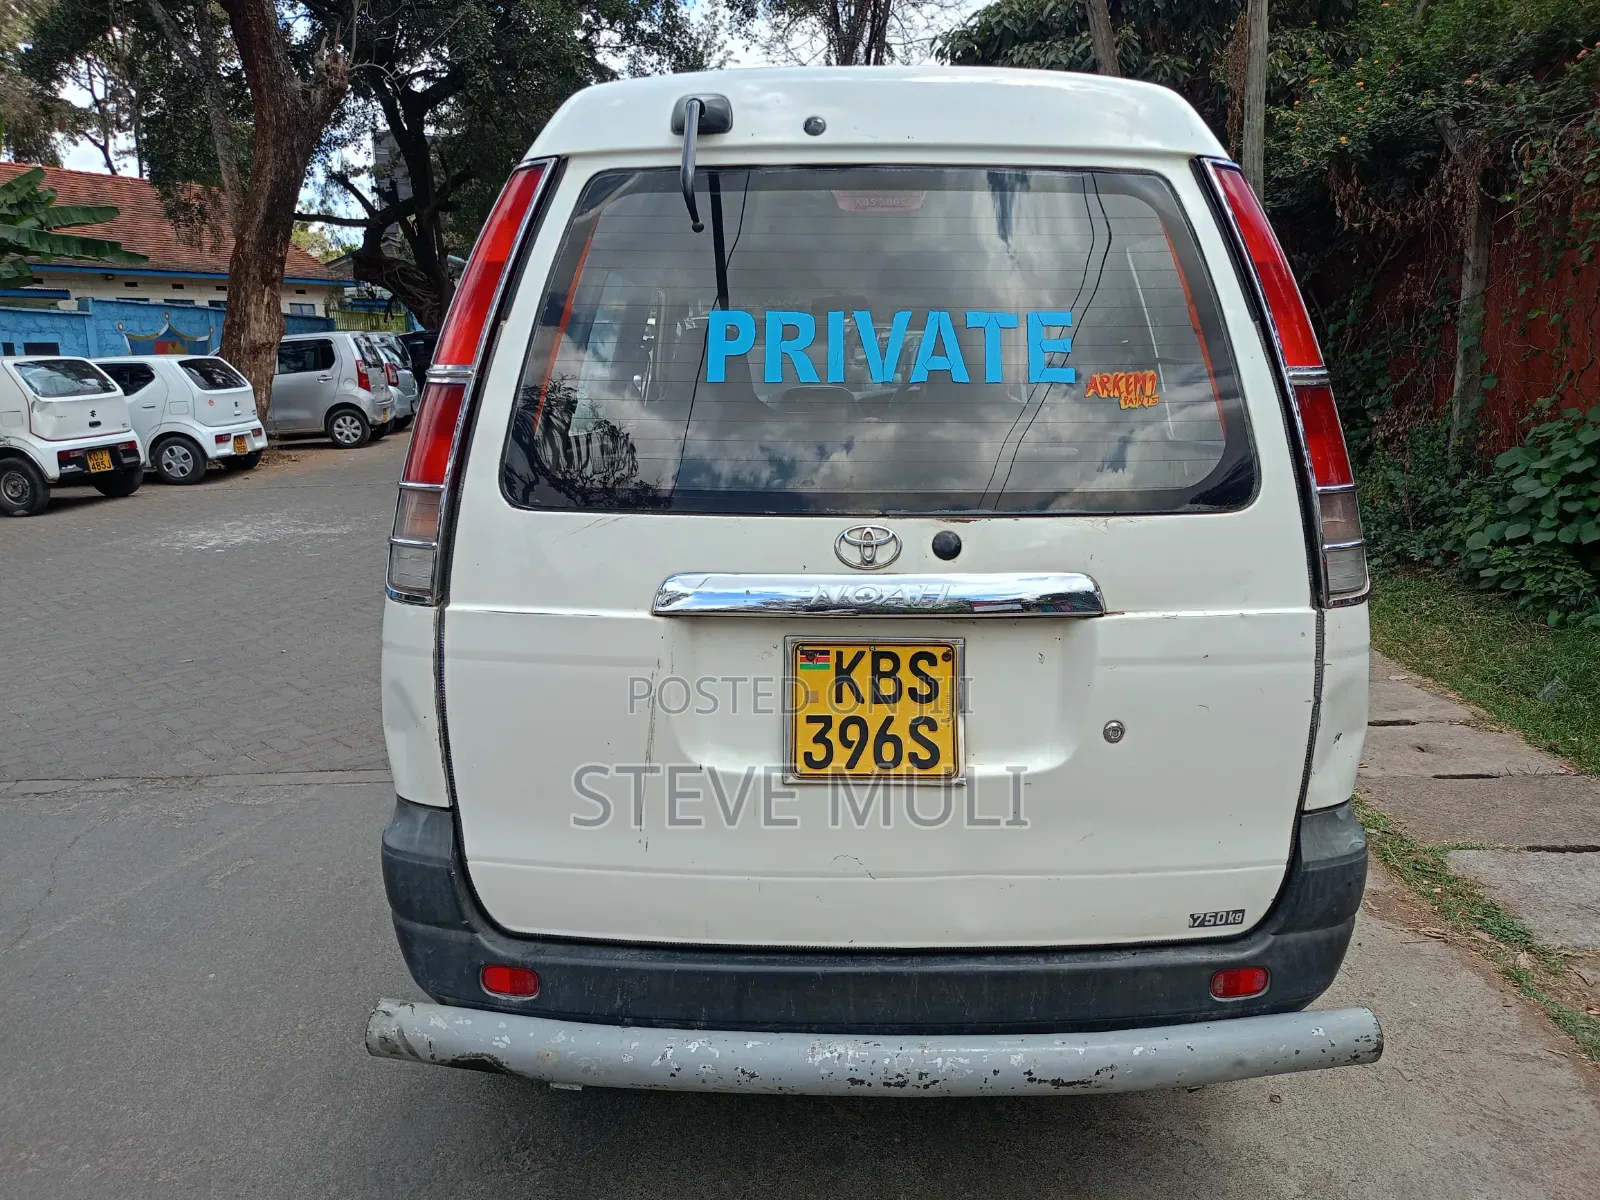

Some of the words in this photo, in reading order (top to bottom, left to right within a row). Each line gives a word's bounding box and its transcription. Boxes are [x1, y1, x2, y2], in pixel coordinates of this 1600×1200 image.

[706, 310, 1076, 383] PRIVATE
[810, 583, 952, 607] NOAH
[834, 650, 939, 704] KBS
[803, 714, 941, 770] 396S
[1193, 910, 1243, 926] 750kg
